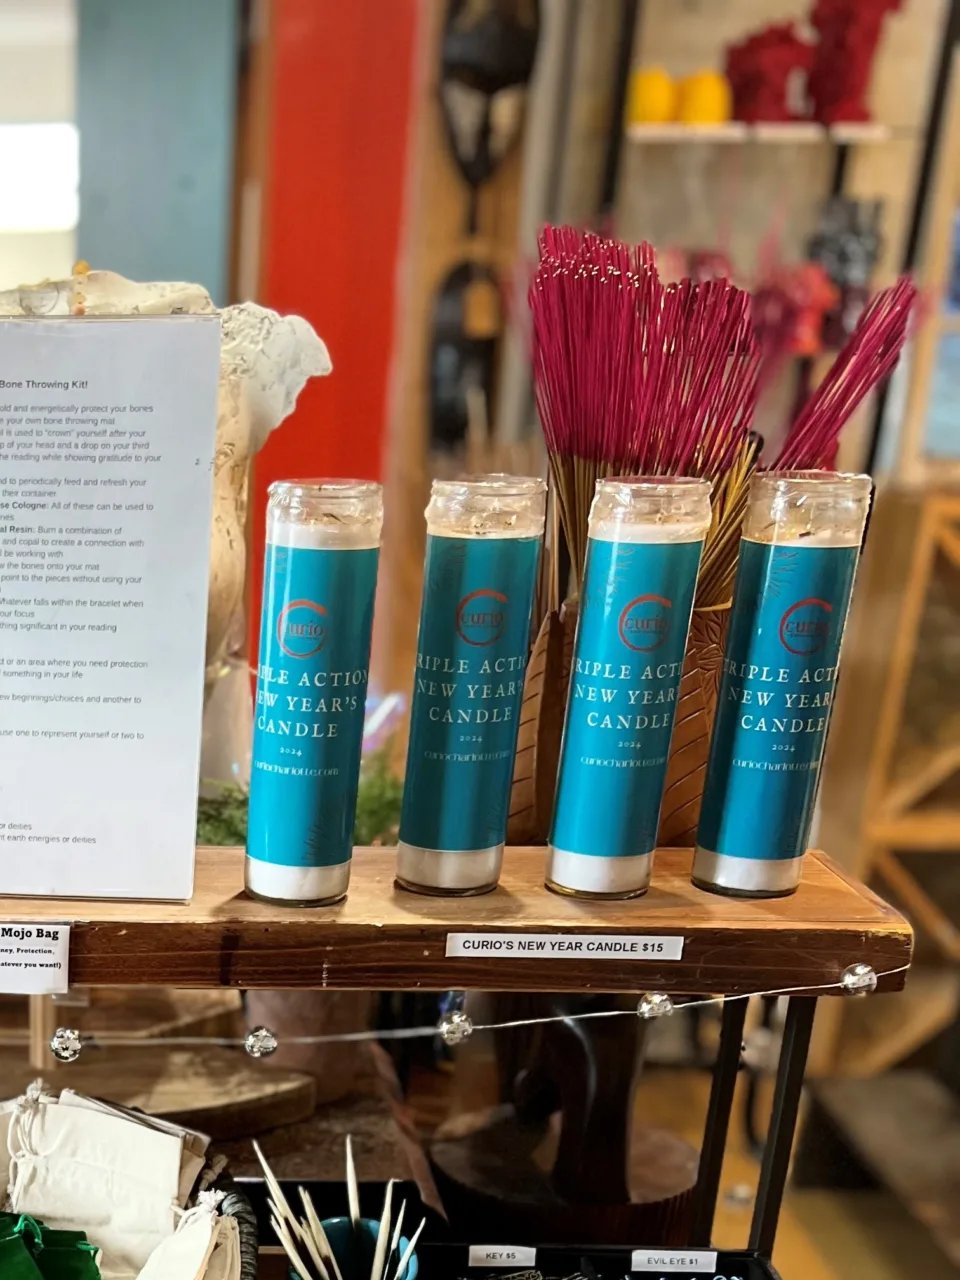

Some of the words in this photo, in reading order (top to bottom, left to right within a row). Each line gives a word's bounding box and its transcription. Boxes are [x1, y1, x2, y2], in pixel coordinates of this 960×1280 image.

[25, 379, 69, 390] Throwing
[71, 380, 88, 388] Kit!
[287, 696, 357, 713] YEAR'S
[429, 707, 512, 724] CANDLE
[587, 712, 670, 730] CANDLE
[257, 717, 338, 738] CANDLE
[741, 716, 825, 733] CANDLE
[280, 746, 303, 757] 2024
[772, 744, 796, 753] 2024
[0, 927, 32, 940] Mojo
[35, 928, 59, 941] Bag
[462, 939, 514, 950] CURIO'S
[517, 940, 546, 950] NEW
[549, 941, 583, 951] YEAR
[586, 941, 638, 952] CANDLE
[642, 942, 663, 952] $15
[485, 1252, 503, 1260] KEY
[647, 1257, 667, 1265] EVIL
[669, 1257, 686, 1265] EYE
